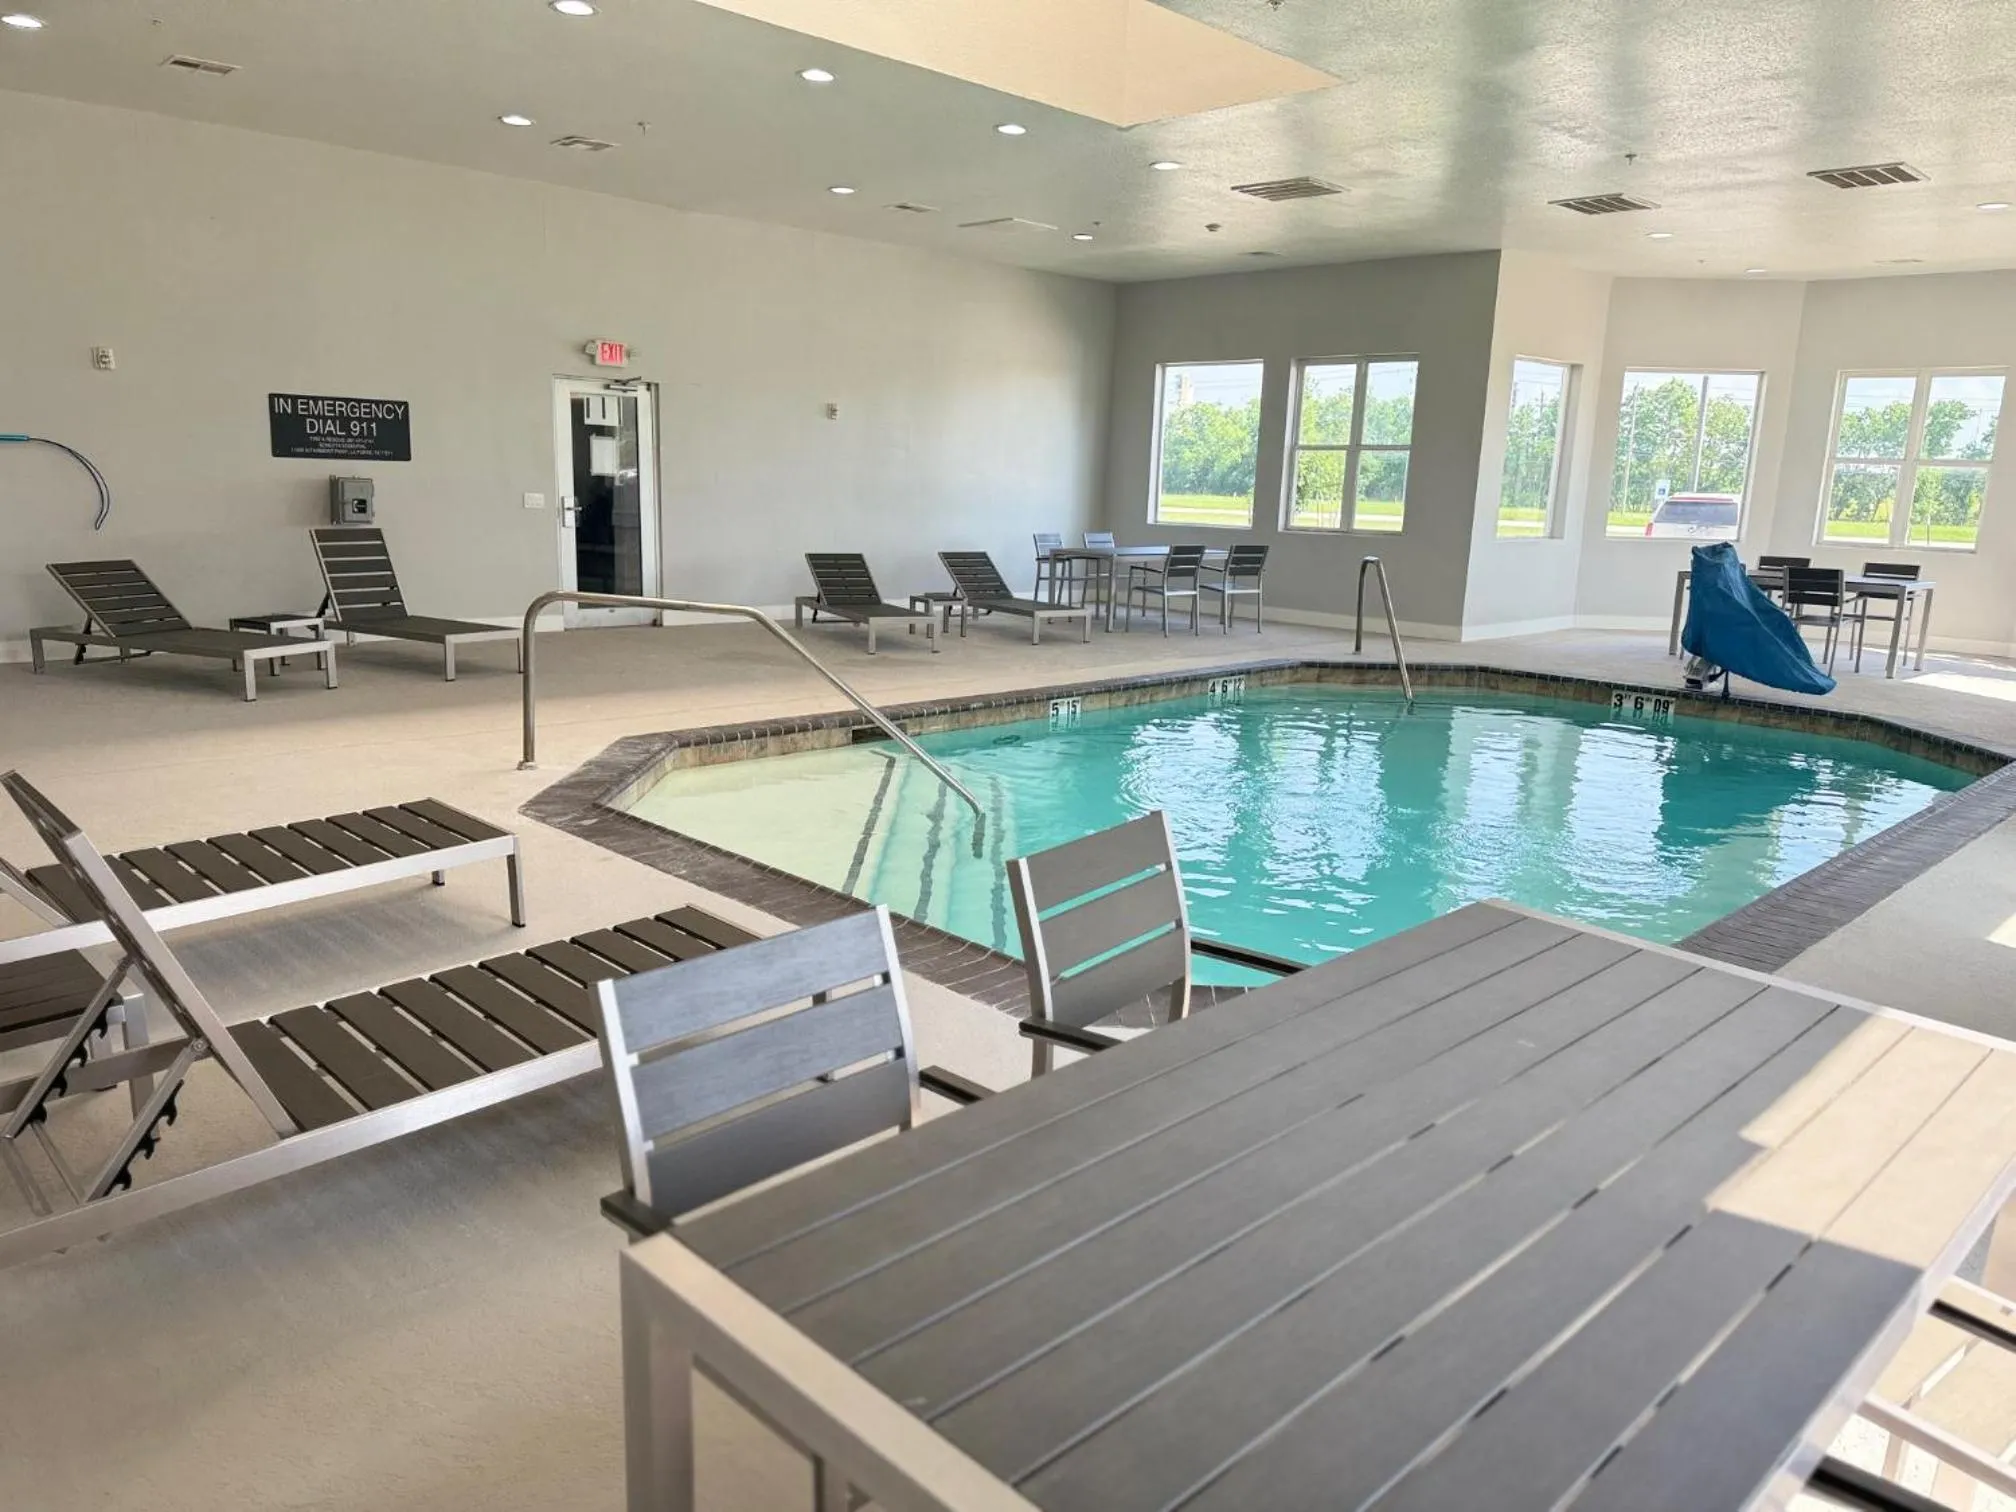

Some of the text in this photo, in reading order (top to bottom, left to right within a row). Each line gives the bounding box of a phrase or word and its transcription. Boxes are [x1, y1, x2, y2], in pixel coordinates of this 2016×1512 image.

[601, 342, 623, 363] EXIT
[274, 397, 406, 421] IN EMERGENCY
[306, 418, 378, 437] DIAL 911
[1209, 681, 1216, 692] 4
[1221, 679, 1228, 693] 6
[1052, 702, 1059, 717] 5
[1613, 693, 1623, 707] 3
[1634, 696, 1644, 710] 6
